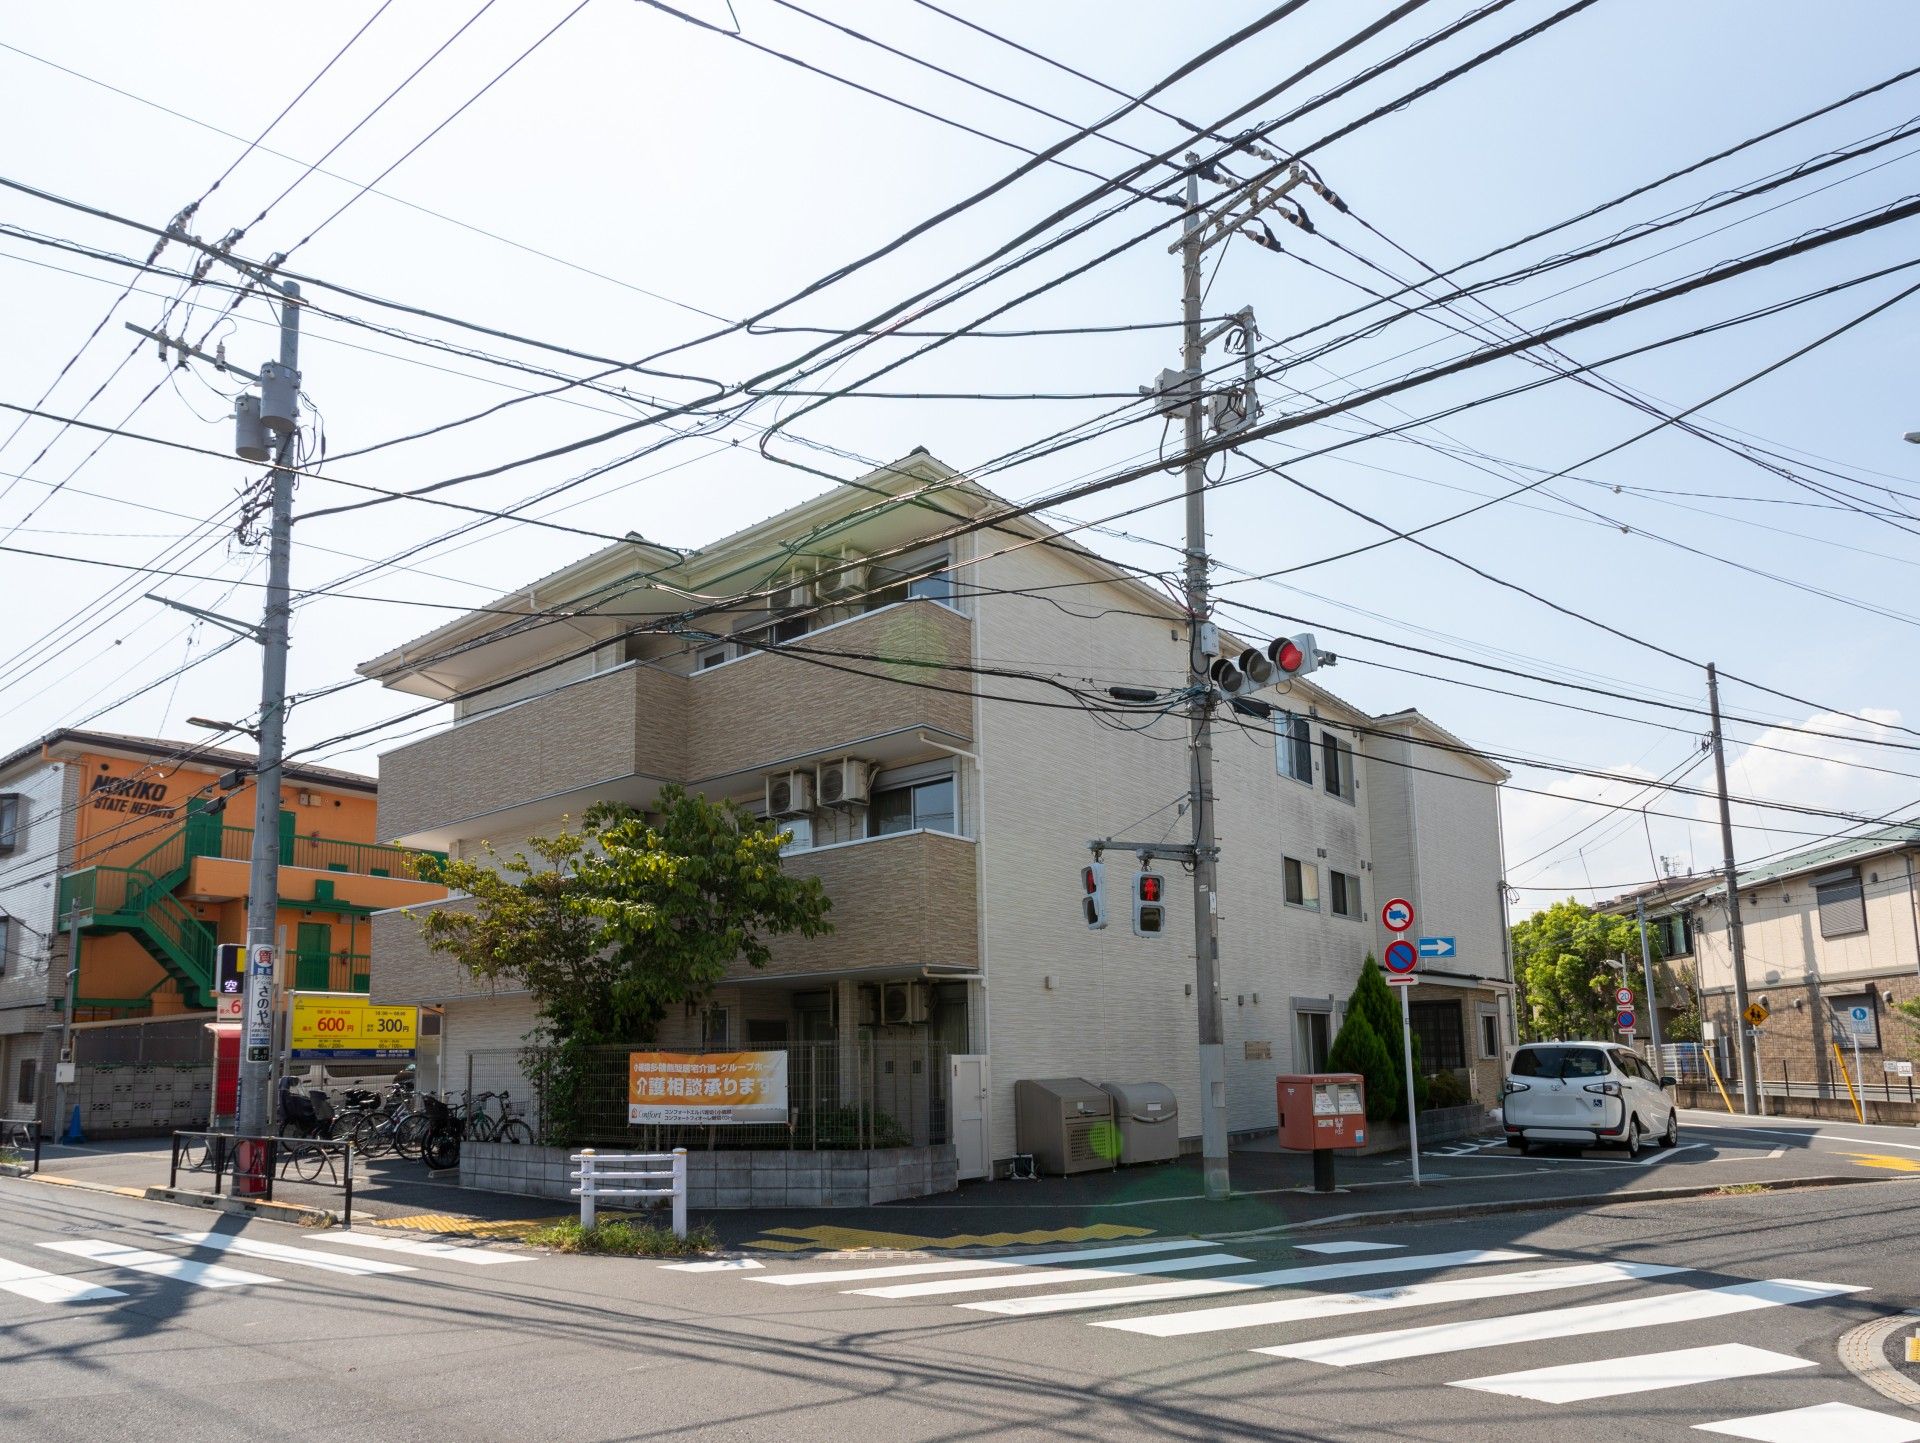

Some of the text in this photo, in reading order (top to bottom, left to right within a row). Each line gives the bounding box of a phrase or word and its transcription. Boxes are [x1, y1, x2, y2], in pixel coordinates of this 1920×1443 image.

[91, 775, 167, 802] NORIKO
[94, 797, 176, 819] STATE HEIGHTS
[224, 980, 238, 993] 空
[257, 984, 269, 1026] さのや
[637, 1076, 774, 1097] 介護相談承ります
